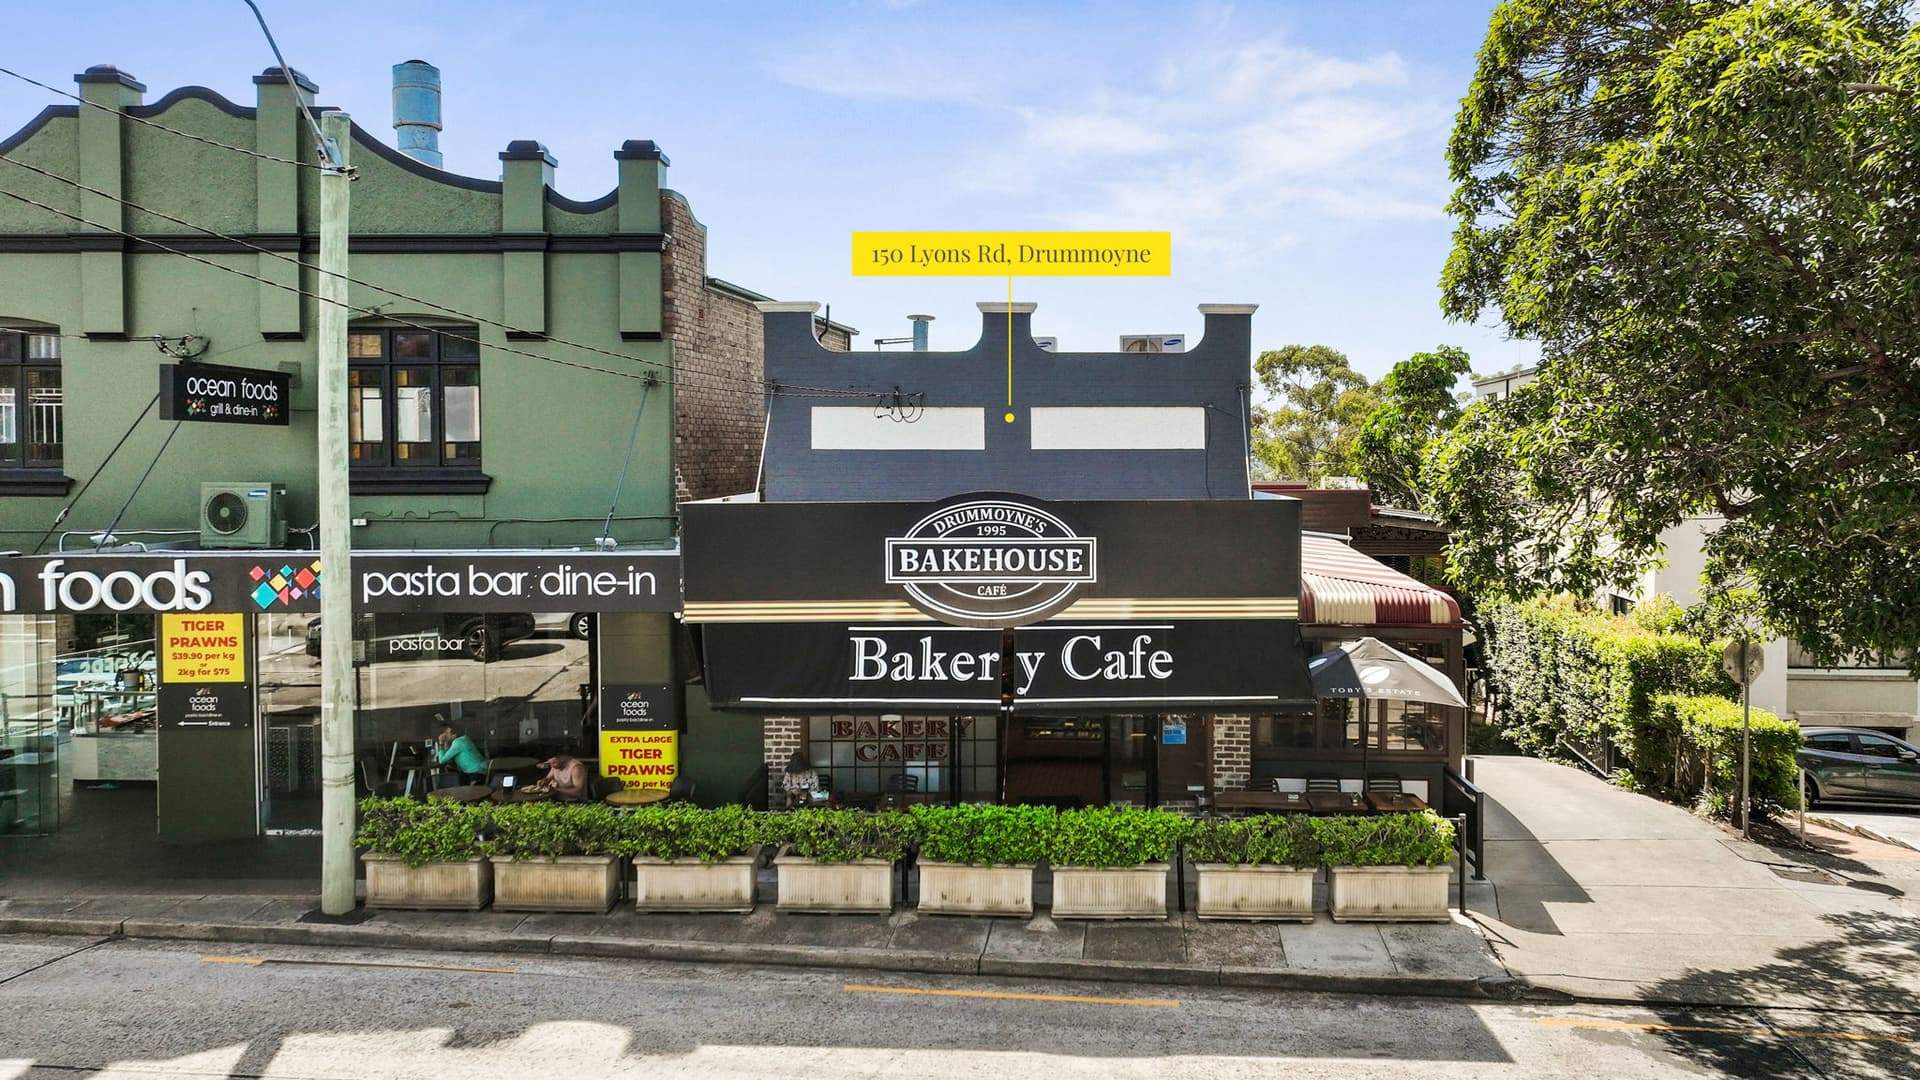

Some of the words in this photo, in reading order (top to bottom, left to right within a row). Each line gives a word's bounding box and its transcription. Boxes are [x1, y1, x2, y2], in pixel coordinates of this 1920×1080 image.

[186, 376, 237, 398] ocean
[240, 377, 279, 401] foods
[209, 402, 224, 417] grill
[224, 402, 232, 415] &
[232, 403, 259, 417] dine-in
[932, 508, 1048, 535] DRUMMOYNE'S
[976, 525, 1007, 537] 1995
[899, 548, 1084, 573] BAKEHOUSE
[37, 558, 213, 612] foods
[362, 564, 461, 604] pasta
[467, 564, 529, 597] bar
[539, 564, 657, 597] dine-in
[976, 583, 1008, 596] CAFÉ
[181, 620, 225, 632] TIGER
[169, 636, 239, 648] PRAWNS
[389, 634, 434, 655] pasta
[437, 635, 466, 651] bar
[171, 652, 203, 661] $39.90
[205, 653, 220, 662] per
[222, 652, 236, 662] kg
[1061, 635, 1175, 681] Cafe
[177, 668, 196, 678] 2kg
[198, 668, 211, 676] for
[213, 667, 231, 676] $75
[1377, 688, 1422, 696] ESTATE
[188, 696, 219, 704] ocean
[620, 701, 650, 709] ocean
[191, 703, 217, 712] foods
[623, 708, 648, 716] foods
[610, 736, 640, 744] EXTRA
[642, 736, 673, 744] LARGE
[620, 749, 662, 760] TIGER
[855, 744, 948, 762] CAFE
[608, 765, 675, 776] PRAWNS
[642, 781, 657, 789] per
